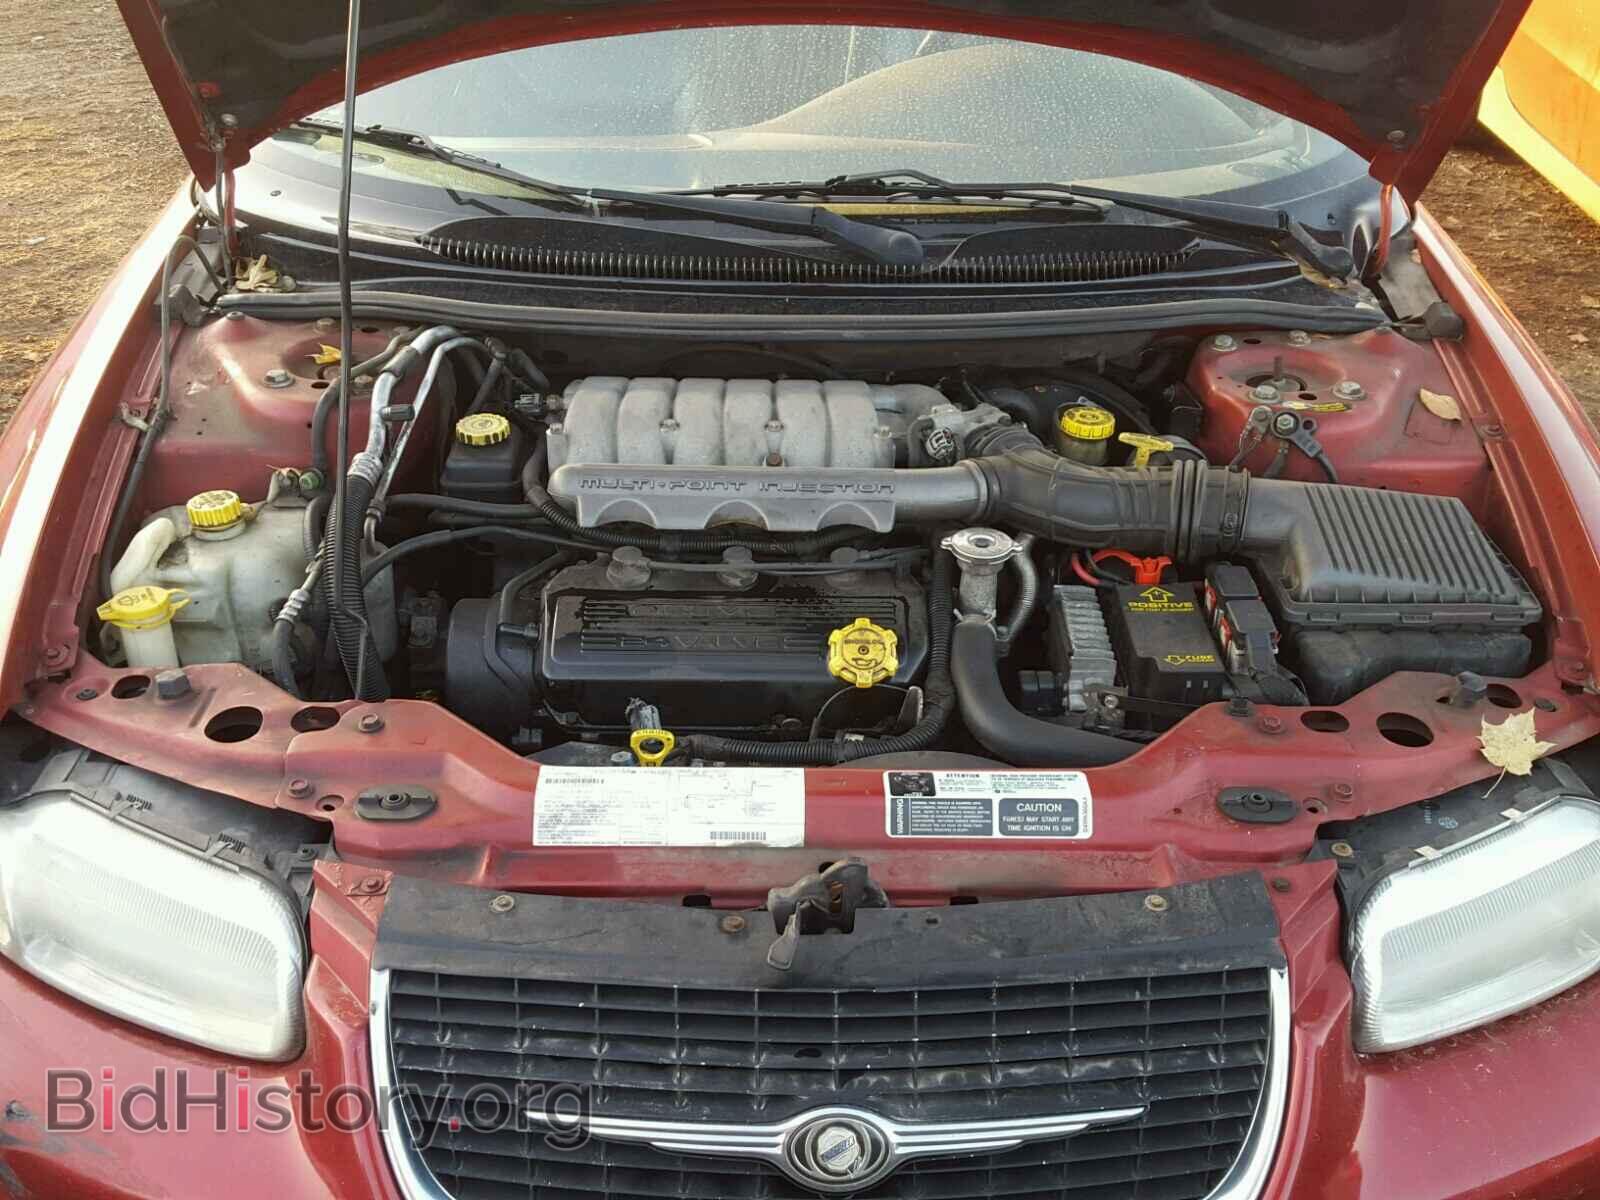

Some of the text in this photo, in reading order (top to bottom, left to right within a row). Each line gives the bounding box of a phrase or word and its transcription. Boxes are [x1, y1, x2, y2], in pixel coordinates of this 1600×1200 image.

[758, 480, 896, 494] INJECTION
[1015, 802, 1063, 813] CAUTION
[896, 798, 904, 835] WARNING
[1040, 815, 1060, 823] START
[1023, 824, 1051, 832] IGNITION
